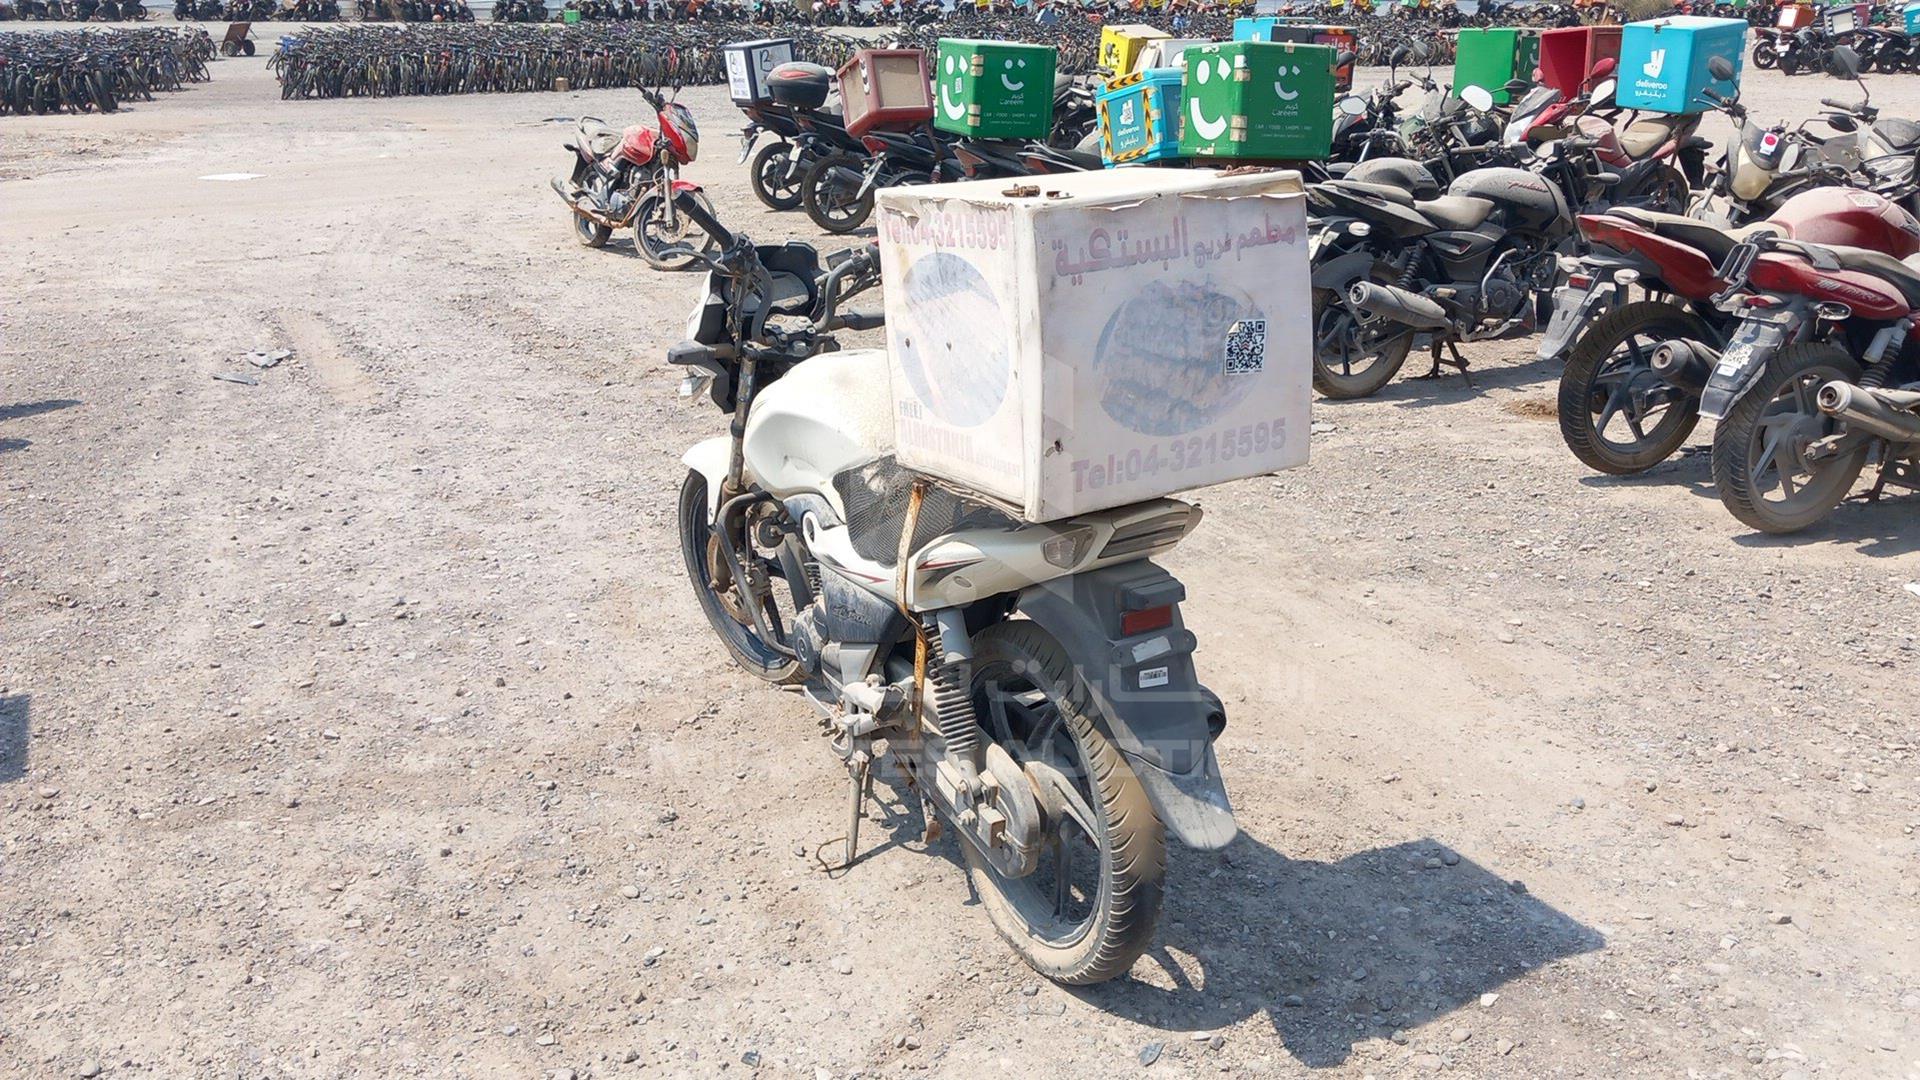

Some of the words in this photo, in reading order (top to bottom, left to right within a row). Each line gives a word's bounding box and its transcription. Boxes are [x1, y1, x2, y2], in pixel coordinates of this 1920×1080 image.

[1635, 78, 1668, 90] deliveroo
[1051, 214, 1189, 286] البستكية
[1236, 211, 1297, 262] مطعم
[1070, 416, 1287, 494] Tel:04-3215595
